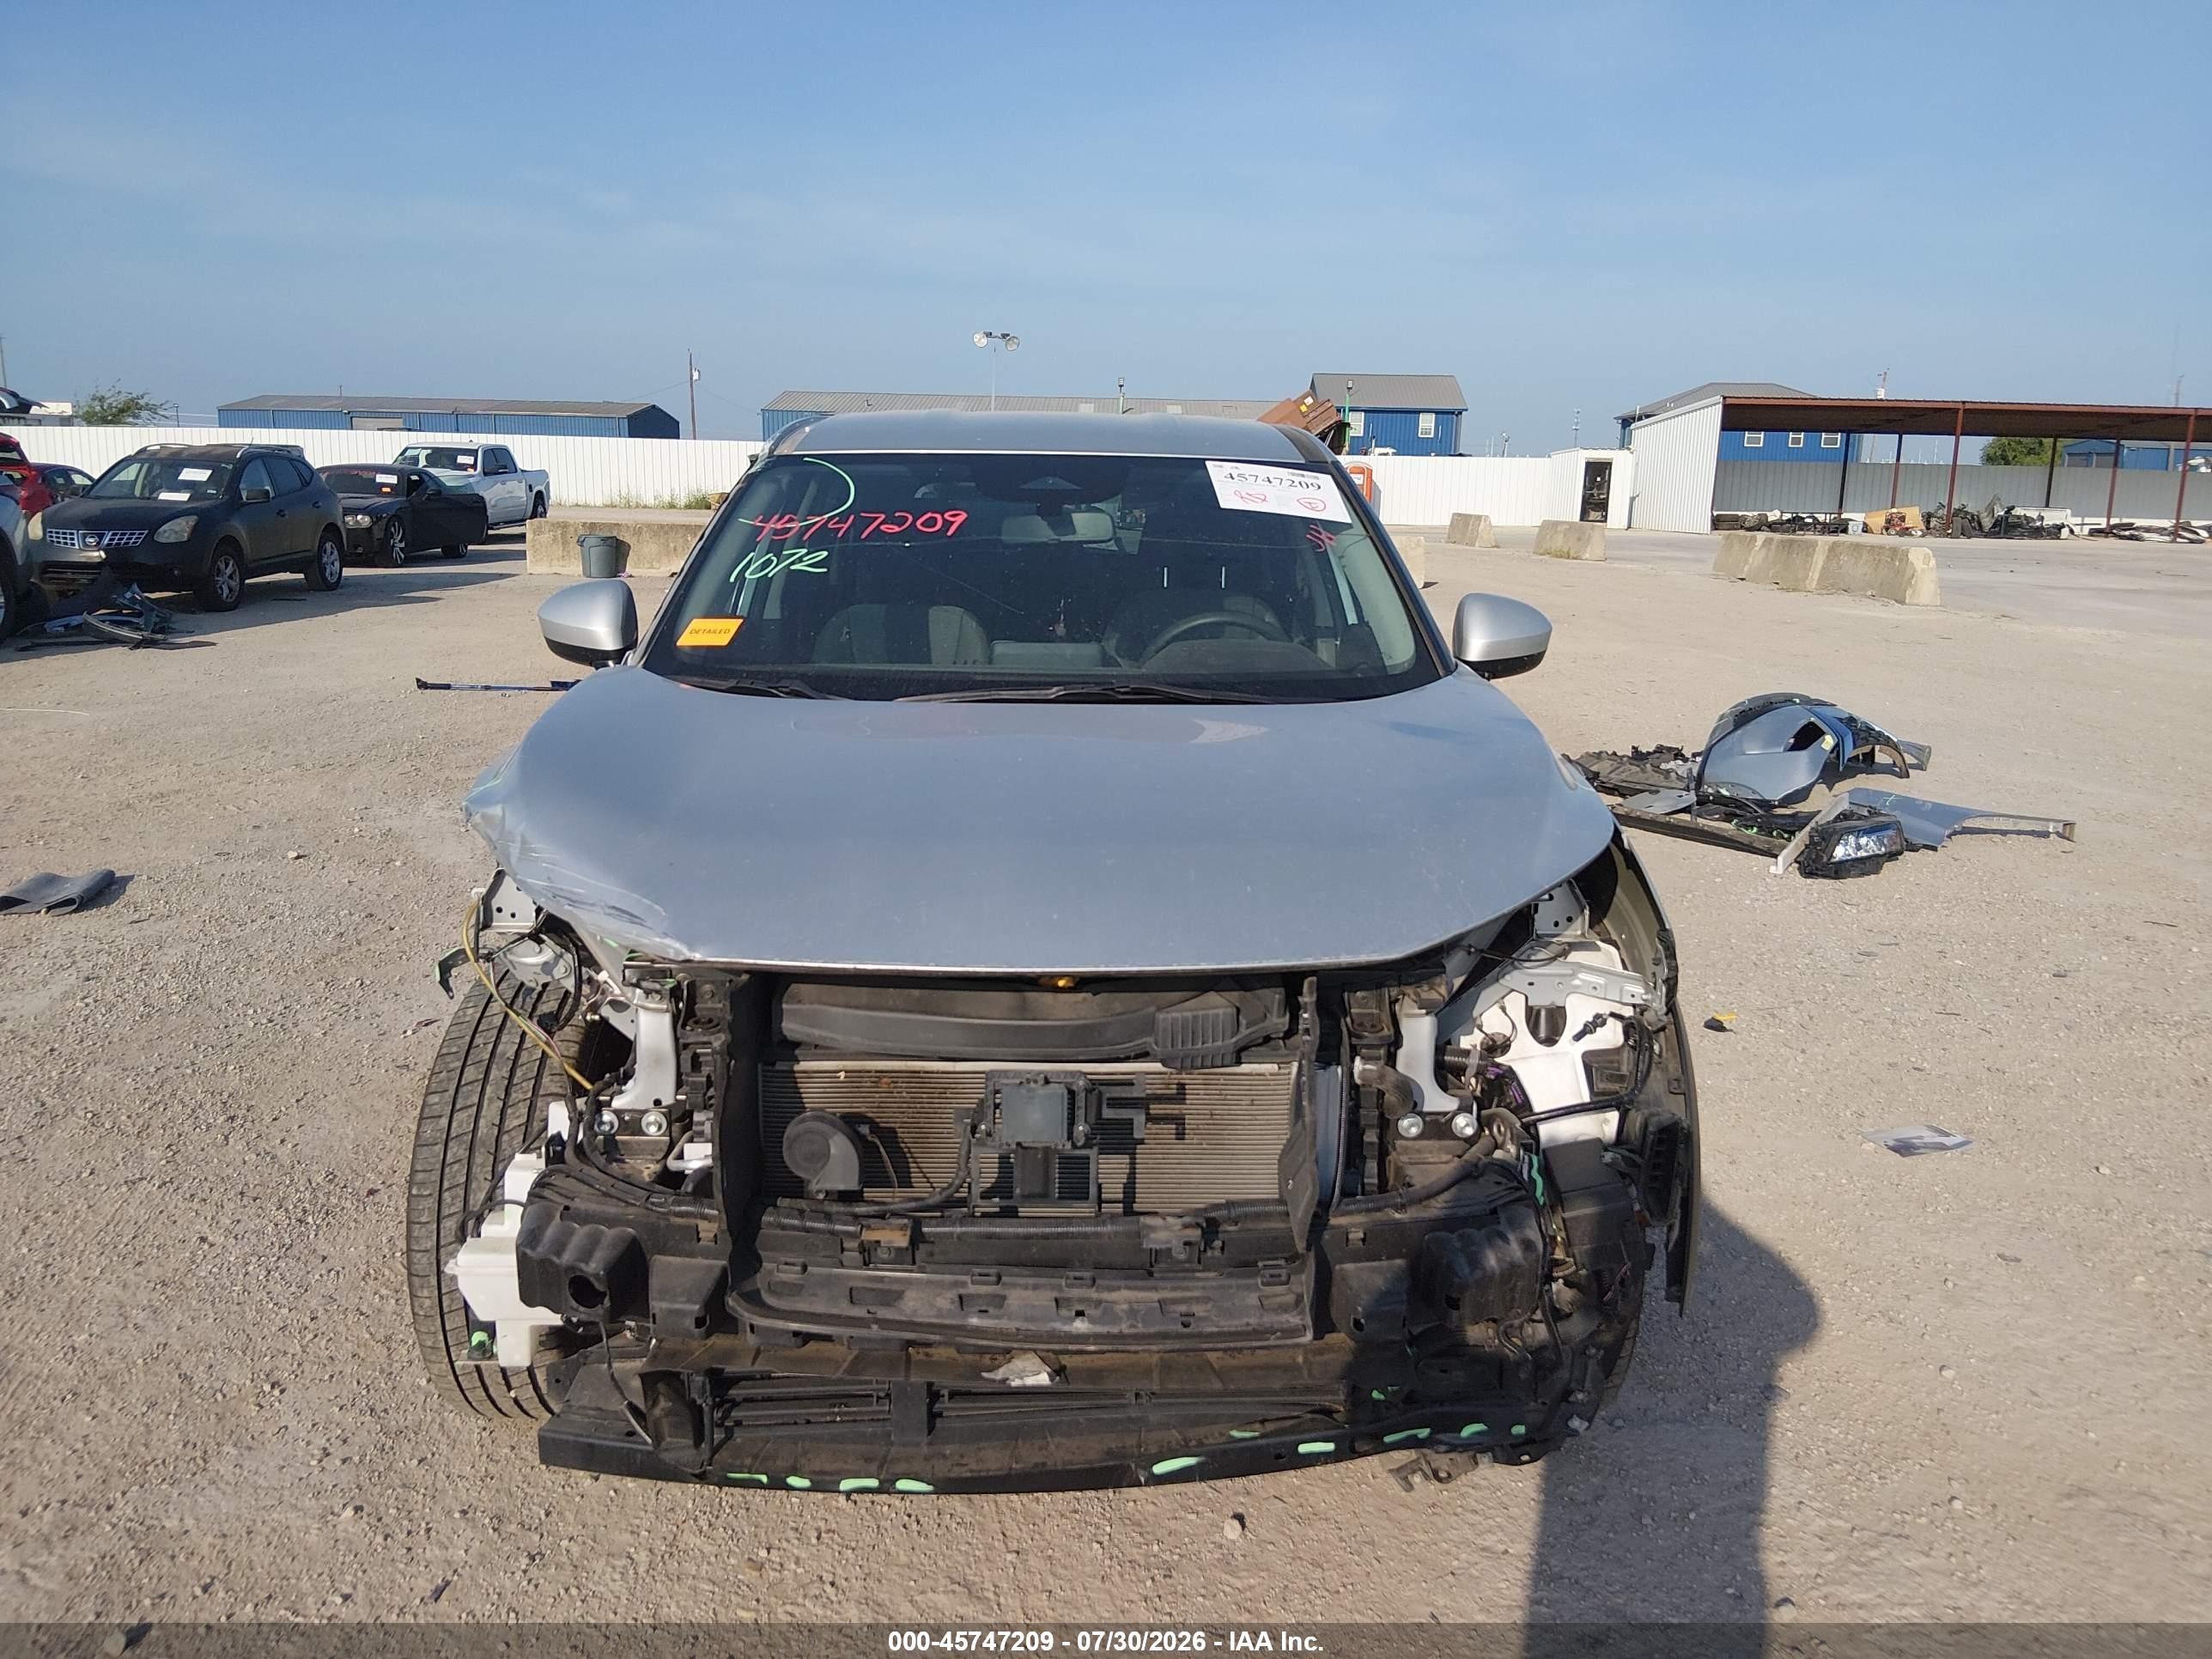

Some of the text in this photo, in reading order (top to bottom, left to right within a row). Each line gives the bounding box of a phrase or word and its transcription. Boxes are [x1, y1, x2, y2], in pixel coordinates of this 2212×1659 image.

[1224, 472, 1322, 491] 45747209
[753, 510, 968, 542] 45747209
[730, 548, 829, 583] 1072
